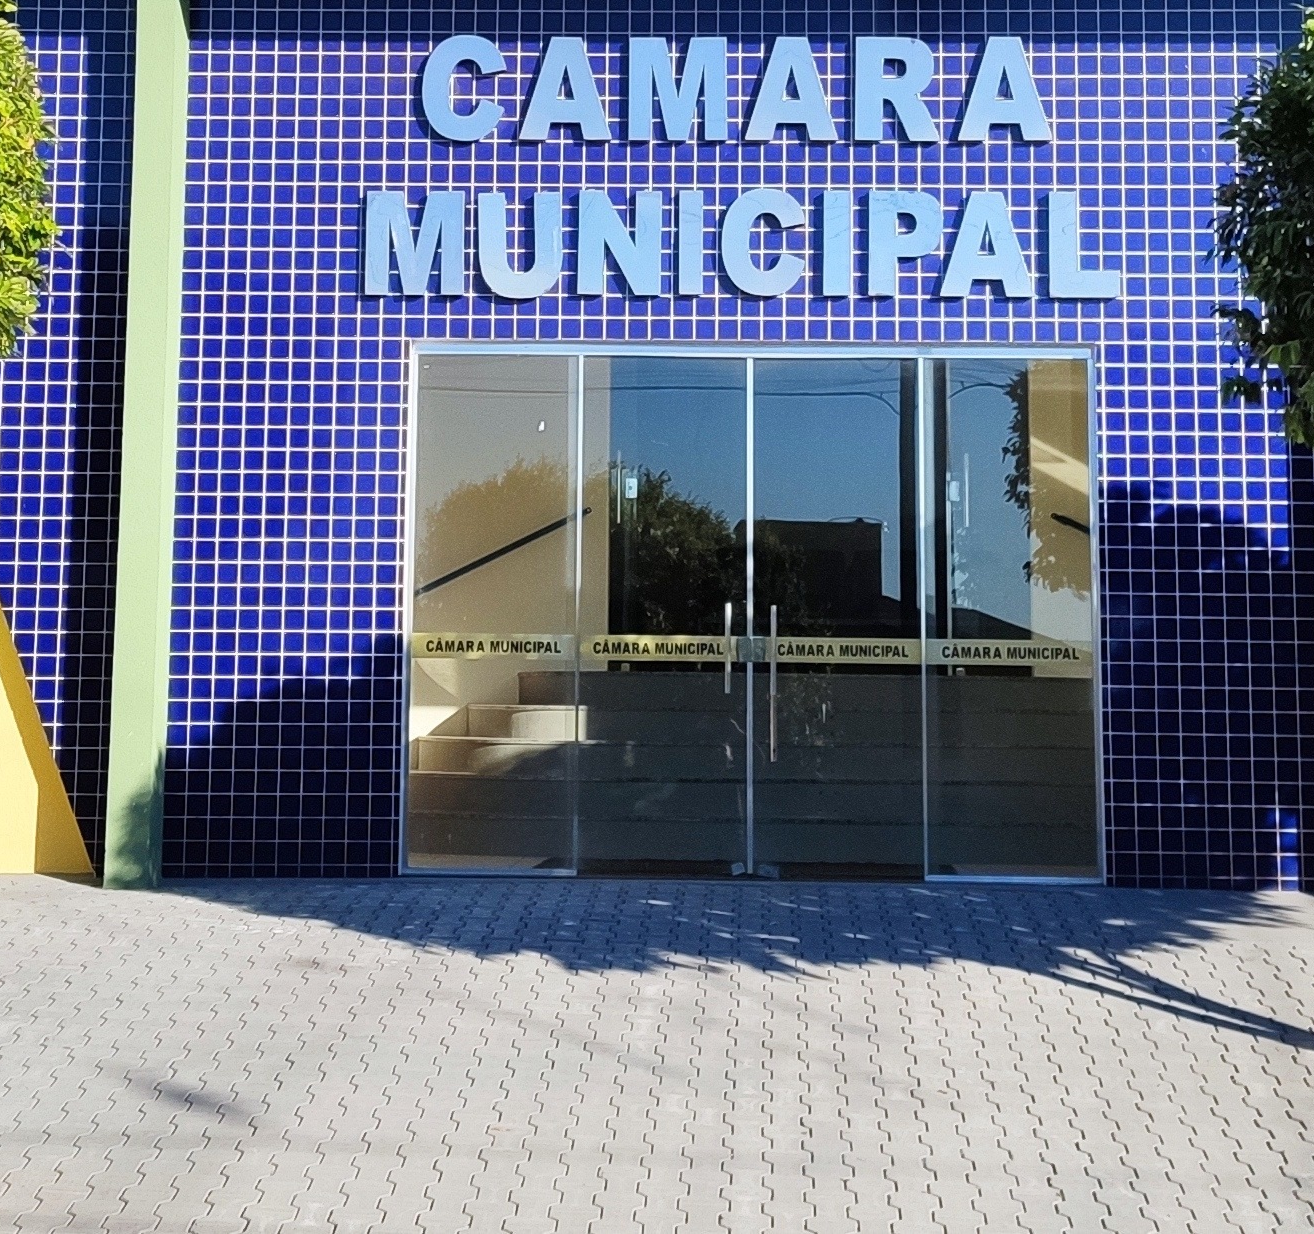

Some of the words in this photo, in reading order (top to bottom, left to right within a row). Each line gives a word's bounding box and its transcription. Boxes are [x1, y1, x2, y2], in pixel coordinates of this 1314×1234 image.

[421, 34, 1052, 143] CAMARA
[364, 188, 1122, 299] MUNICIPAL
[425, 639, 485, 652] CÂMARA
[489, 640, 562, 654] MUNICIPAL
[593, 639, 651, 655] CÂMARA
[654, 641, 724, 655] MUNICIPAL
[777, 640, 835, 657] CÂMARA
[839, 644, 909, 658] MUNICIPAL
[941, 643, 1002, 659] CÂMARA
[1006, 646, 1080, 660] MUNICIPAL
